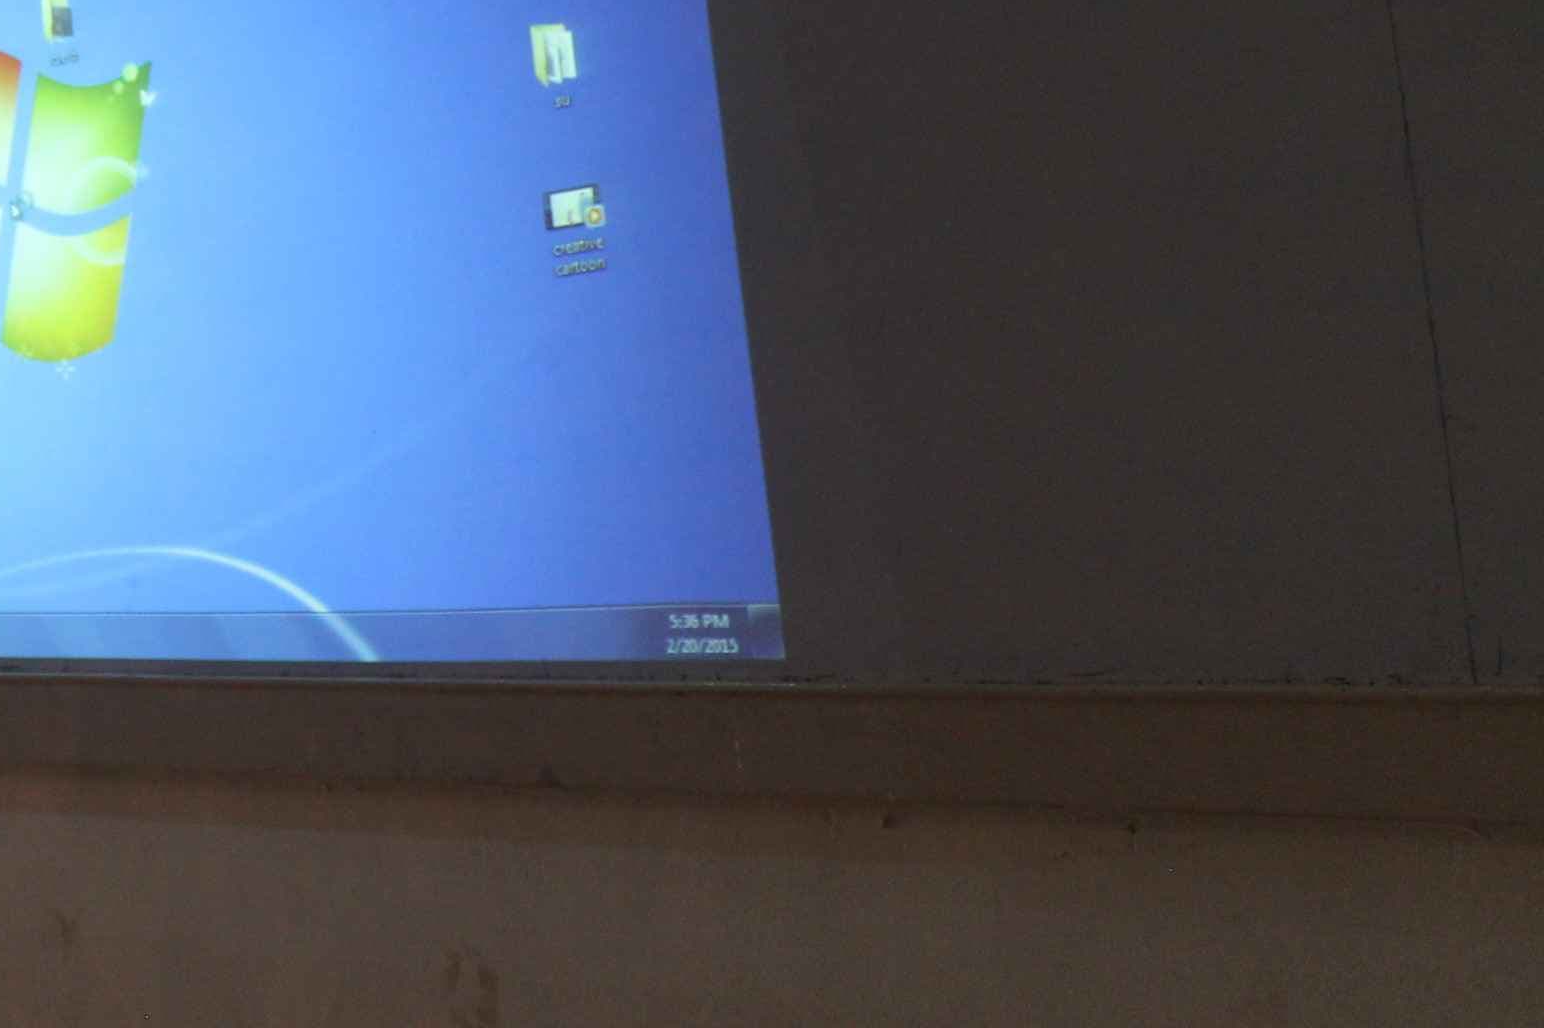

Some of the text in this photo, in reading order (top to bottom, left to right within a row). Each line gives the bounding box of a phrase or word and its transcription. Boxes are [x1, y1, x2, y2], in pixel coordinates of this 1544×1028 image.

[552, 237, 606, 256] creative
[554, 257, 607, 277] cartoon
[668, 613, 730, 629] 5:36 PM
[667, 637, 739, 654] 2/20/2015
